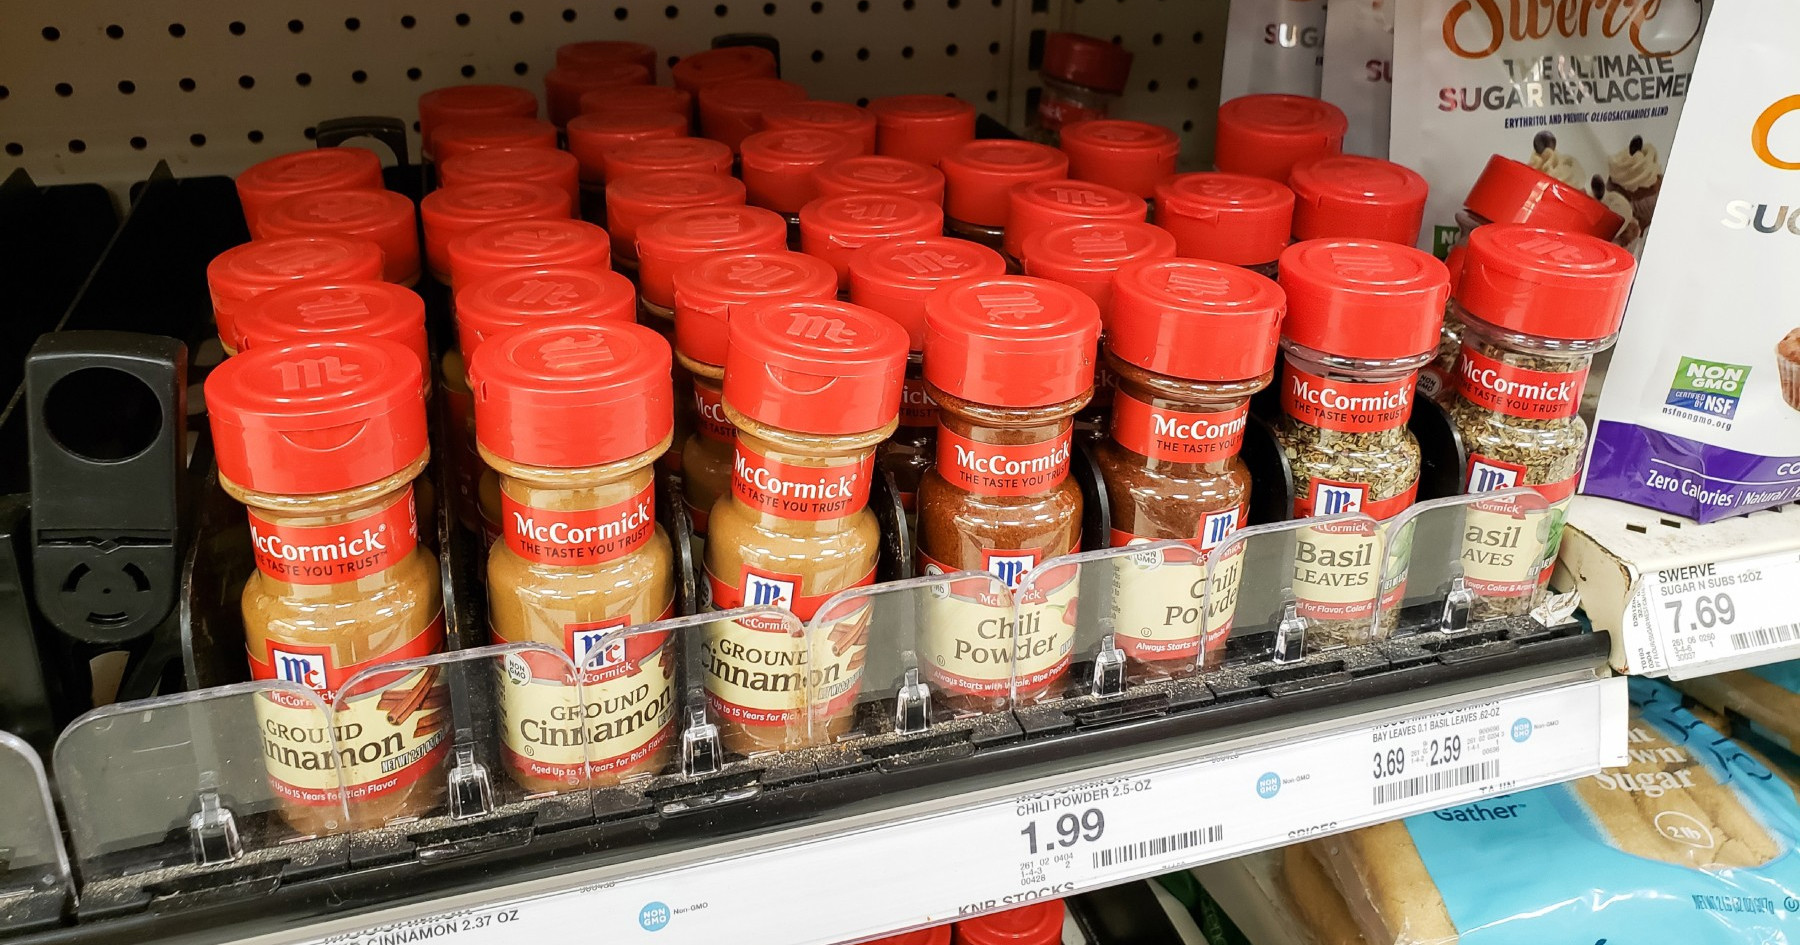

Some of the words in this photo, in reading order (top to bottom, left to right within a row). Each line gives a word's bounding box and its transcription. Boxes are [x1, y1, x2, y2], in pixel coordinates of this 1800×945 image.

[1264, 23, 1324, 48] SUG
[1503, 56, 1553, 82] THE
[1557, 51, 1675, 81] ULTIMATE
[1438, 83, 1543, 112] SUGAR
[1504, 116, 1547, 129] ERYTHRITOL
[1549, 114, 1562, 125] AND
[1420, 374, 1437, 386] NON
[1461, 354, 1570, 401] McCormick
[1687, 362, 1744, 381] NON
[1292, 375, 1409, 412] McCormick
[1692, 378, 1738, 392] GMO
[1474, 386, 1502, 405] TASTE
[1506, 398, 1529, 411] YOU
[1533, 402, 1563, 413] TRUST
[1675, 391, 1706, 401] CERTIFIED
[1704, 395, 1734, 415] NSF
[1694, 400, 1704, 408] BY
[1152, 409, 1248, 440] McCormi
[1294, 401, 1311, 414] THE
[1314, 407, 1347, 423] TASTE
[1351, 414, 1374, 424] YOU
[1378, 407, 1405, 422] TRUST
[1662, 406, 1732, 431] nsfnongmo.org
[1156, 439, 1179, 452] THE
[1182, 444, 1216, 453] TASTE
[1219, 440, 1235, 450] YOU
[954, 442, 1069, 476] McCormick
[734, 448, 853, 499] McCormick
[959, 470, 979, 485] THE
[983, 477, 1018, 488] TASTE
[1022, 474, 1044, 487] YOU
[734, 476, 746, 493] THE
[748, 487, 779, 508] TASTE
[782, 500, 808, 512] YOU
[812, 499, 846, 513] TRUST
[1646, 469, 1679, 492] Zero
[1681, 479, 1734, 507] Calories
[1742, 486, 1785, 506] Natural
[512, 501, 650, 545] McCormick
[250, 525, 386, 562] McCormick
[520, 539, 541, 555] THE
[544, 546, 584, 558] TASTE
[588, 541, 615, 555] YOU
[618, 526, 648, 550] TRUST
[1295, 540, 1373, 567] Basil
[267, 556, 300, 576] TASTE
[304, 564, 333, 577] YOU
[336, 552, 380, 574] TRUST
[1294, 566, 1369, 587] LEAVES
[1658, 562, 1717, 584] SWERVE
[1190, 560, 1239, 599] Chili
[1487, 583, 1508, 592] Color
[1509, 583, 1515, 591] &
[1660, 581, 1697, 597] SUGAR
[1699, 581, 1706, 590] N
[1708, 575, 1736, 589] SUBS
[1304, 601, 1316, 612] for
[1317, 605, 1344, 614] Flavor,
[1346, 605, 1366, 613] Color
[1664, 592, 1736, 634] 7.69
[977, 610, 1041, 640] Chili
[719, 638, 809, 666] GROUND
[953, 632, 1057, 664] Powder
[1135, 641, 1166, 652] Always
[1167, 641, 1191, 651] Starts
[509, 660, 525, 672] NON
[509, 667, 527, 680] GMO
[701, 642, 840, 692] Cinnamon
[933, 670, 957, 686] Always
[958, 678, 983, 690] Starts
[984, 681, 1003, 690] with
[1032, 672, 1048, 684] Ripe
[520, 685, 671, 747] Cinnamon
[713, 700, 723, 712] Up
[723, 704, 731, 714] to
[731, 707, 741, 717] 15
[742, 709, 765, 721] Years
[766, 712, 779, 722] for
[266, 718, 363, 744] GROUND
[1372, 730, 1388, 743] BAY
[1388, 723, 1417, 740] LEAVES
[1417, 721, 1428, 733] 0.1
[1429, 716, 1450, 731] BASIL
[1450, 710, 1478, 727] LEAVES
[1478, 707, 1501, 722] .62-OZ
[1513, 723, 1530, 731] NON
[1513, 730, 1530, 738] GMO
[263, 731, 406, 771] innamon
[531, 763, 551, 775] Aged
[552, 766, 564, 777] Up
[566, 766, 577, 776] to
[590, 761, 615, 773] Years
[616, 756, 629, 768] for
[630, 748, 647, 763] Rich
[1372, 746, 1405, 779] 3.69
[1429, 734, 1462, 767] 2.59
[275, 781, 284, 793] Up
[284, 786, 292, 796] to
[292, 789, 300, 799] 15
[301, 791, 326, 801] Years
[367, 778, 398, 794] Flavor
[1260, 777, 1278, 787] NON
[1260, 784, 1278, 794] GMO
[1282, 774, 1311, 785] Non-GMO
[1594, 768, 1697, 799] Sugar
[1016, 802, 1050, 817] CHILI
[1053, 789, 1110, 810] POWDER
[1112, 778, 1153, 798] 2.5-OZ
[1433, 803, 1521, 825] Gather
[1020, 807, 1105, 855] 1.99
[1020, 861, 1034, 871] 261
[1039, 857, 1050, 867] 02
[1053, 852, 1074, 864] 0404
[1020, 867, 1043, 879] 1-4-3
[1065, 861, 1071, 869] 2
[1020, 875, 1046, 886] 00428
[643, 907, 666, 919] NON
[643, 915, 667, 926] GMO
[673, 902, 709, 915] Non-GMO
[367, 921, 458, 945] CINNAMON
[462, 914, 493, 932] 2.37
[497, 909, 520, 923] OZ
